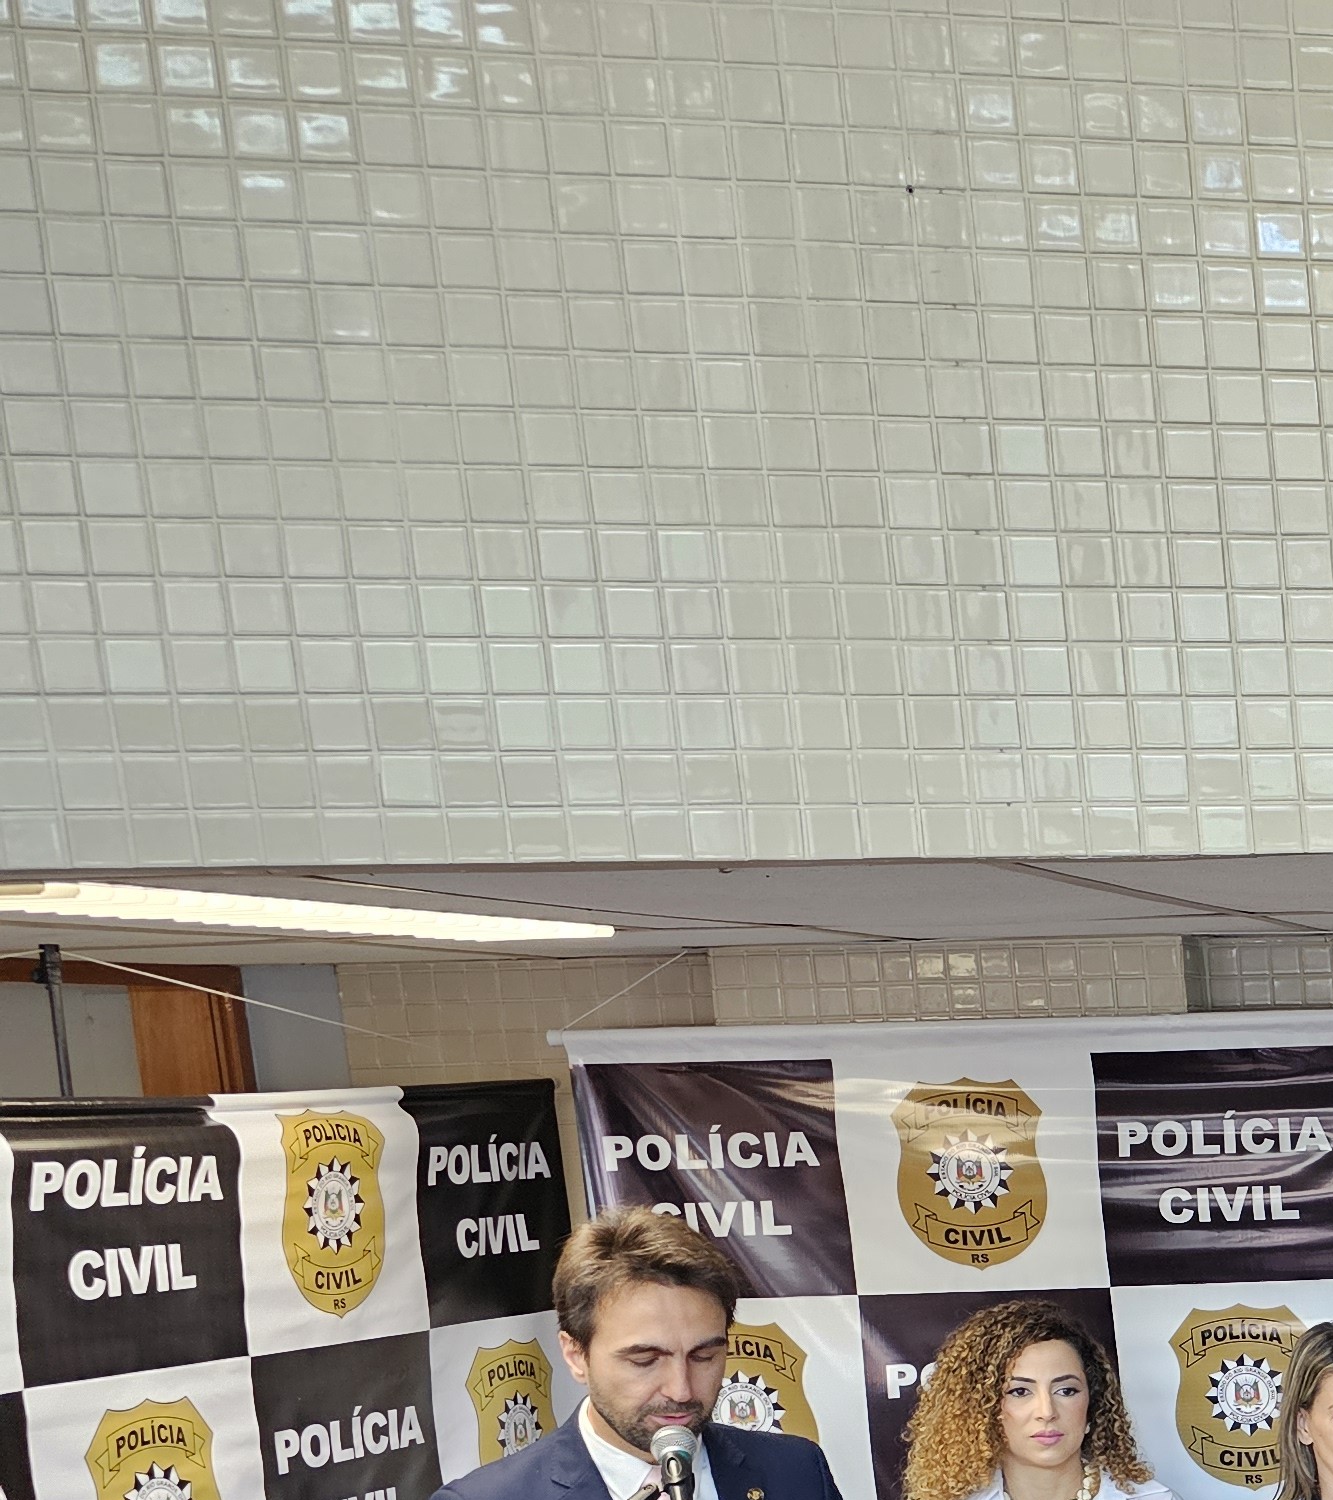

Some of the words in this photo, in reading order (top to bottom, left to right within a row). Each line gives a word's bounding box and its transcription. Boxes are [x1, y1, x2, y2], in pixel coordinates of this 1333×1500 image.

[924, 1092, 1007, 1121] POLÍCIA
[302, 1119, 364, 1148] POLÍCIA
[1117, 1109, 1332, 1157] POLÍCIA
[427, 1133, 552, 1187] POLÍCIA
[604, 1124, 821, 1172] POLÍCIA
[28, 1145, 224, 1212] POLÍCIA
[651, 1199, 793, 1238] IVIL
[1158, 1185, 1300, 1225] CIVIL
[455, 1213, 541, 1259] CIVIL
[944, 1226, 1012, 1247] CIVIL
[68, 1243, 198, 1301] CIVIL
[970, 1253, 990, 1264] RS
[314, 1265, 363, 1291] CIVIL
[333, 1297, 347, 1311] RS
[1200, 1319, 1283, 1347] POLÍCIA
[727, 1336, 776, 1361] ÍCIA
[487, 1355, 537, 1384] POLÍCIA
[115, 1418, 188, 1452] POLÍCIA
[273, 1405, 426, 1476] POLÍCIA
[1220, 1449, 1280, 1467] CIVIL
[1245, 1475, 1263, 1484] RS
